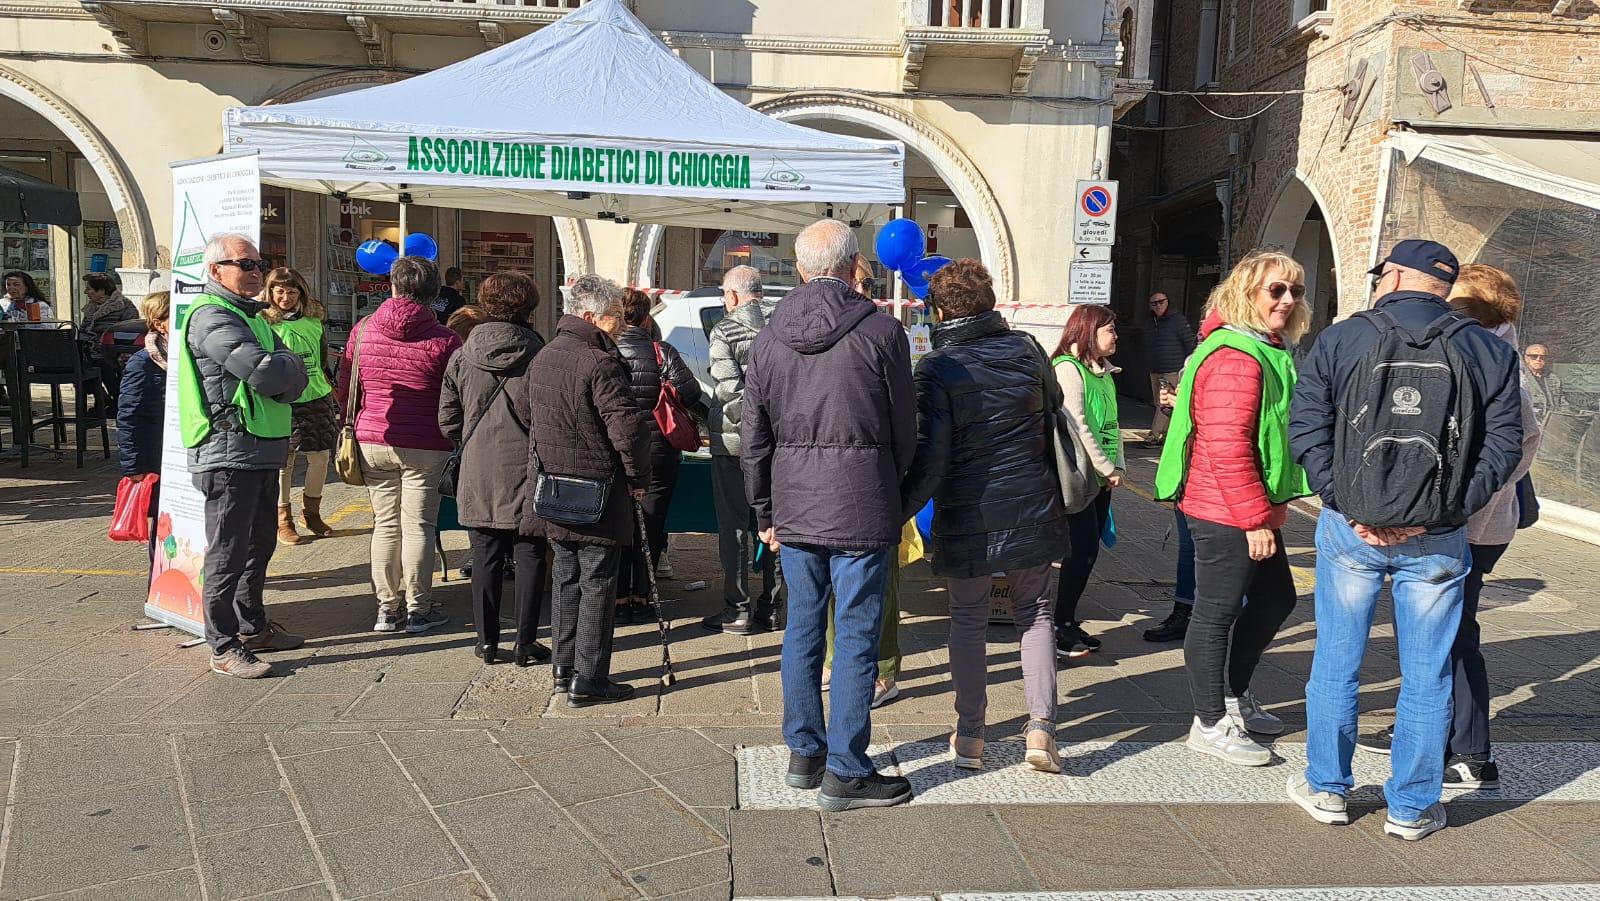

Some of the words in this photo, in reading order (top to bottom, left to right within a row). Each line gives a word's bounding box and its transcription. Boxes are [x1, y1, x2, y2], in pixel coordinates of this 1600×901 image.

[407, 136, 546, 179] ASSOCIAZIONE
[551, 145, 640, 184] DIABETICI
[645, 150, 663, 185] DI
[668, 151, 751, 189] CHIOGGIA
[368, 283, 390, 292] SCO
